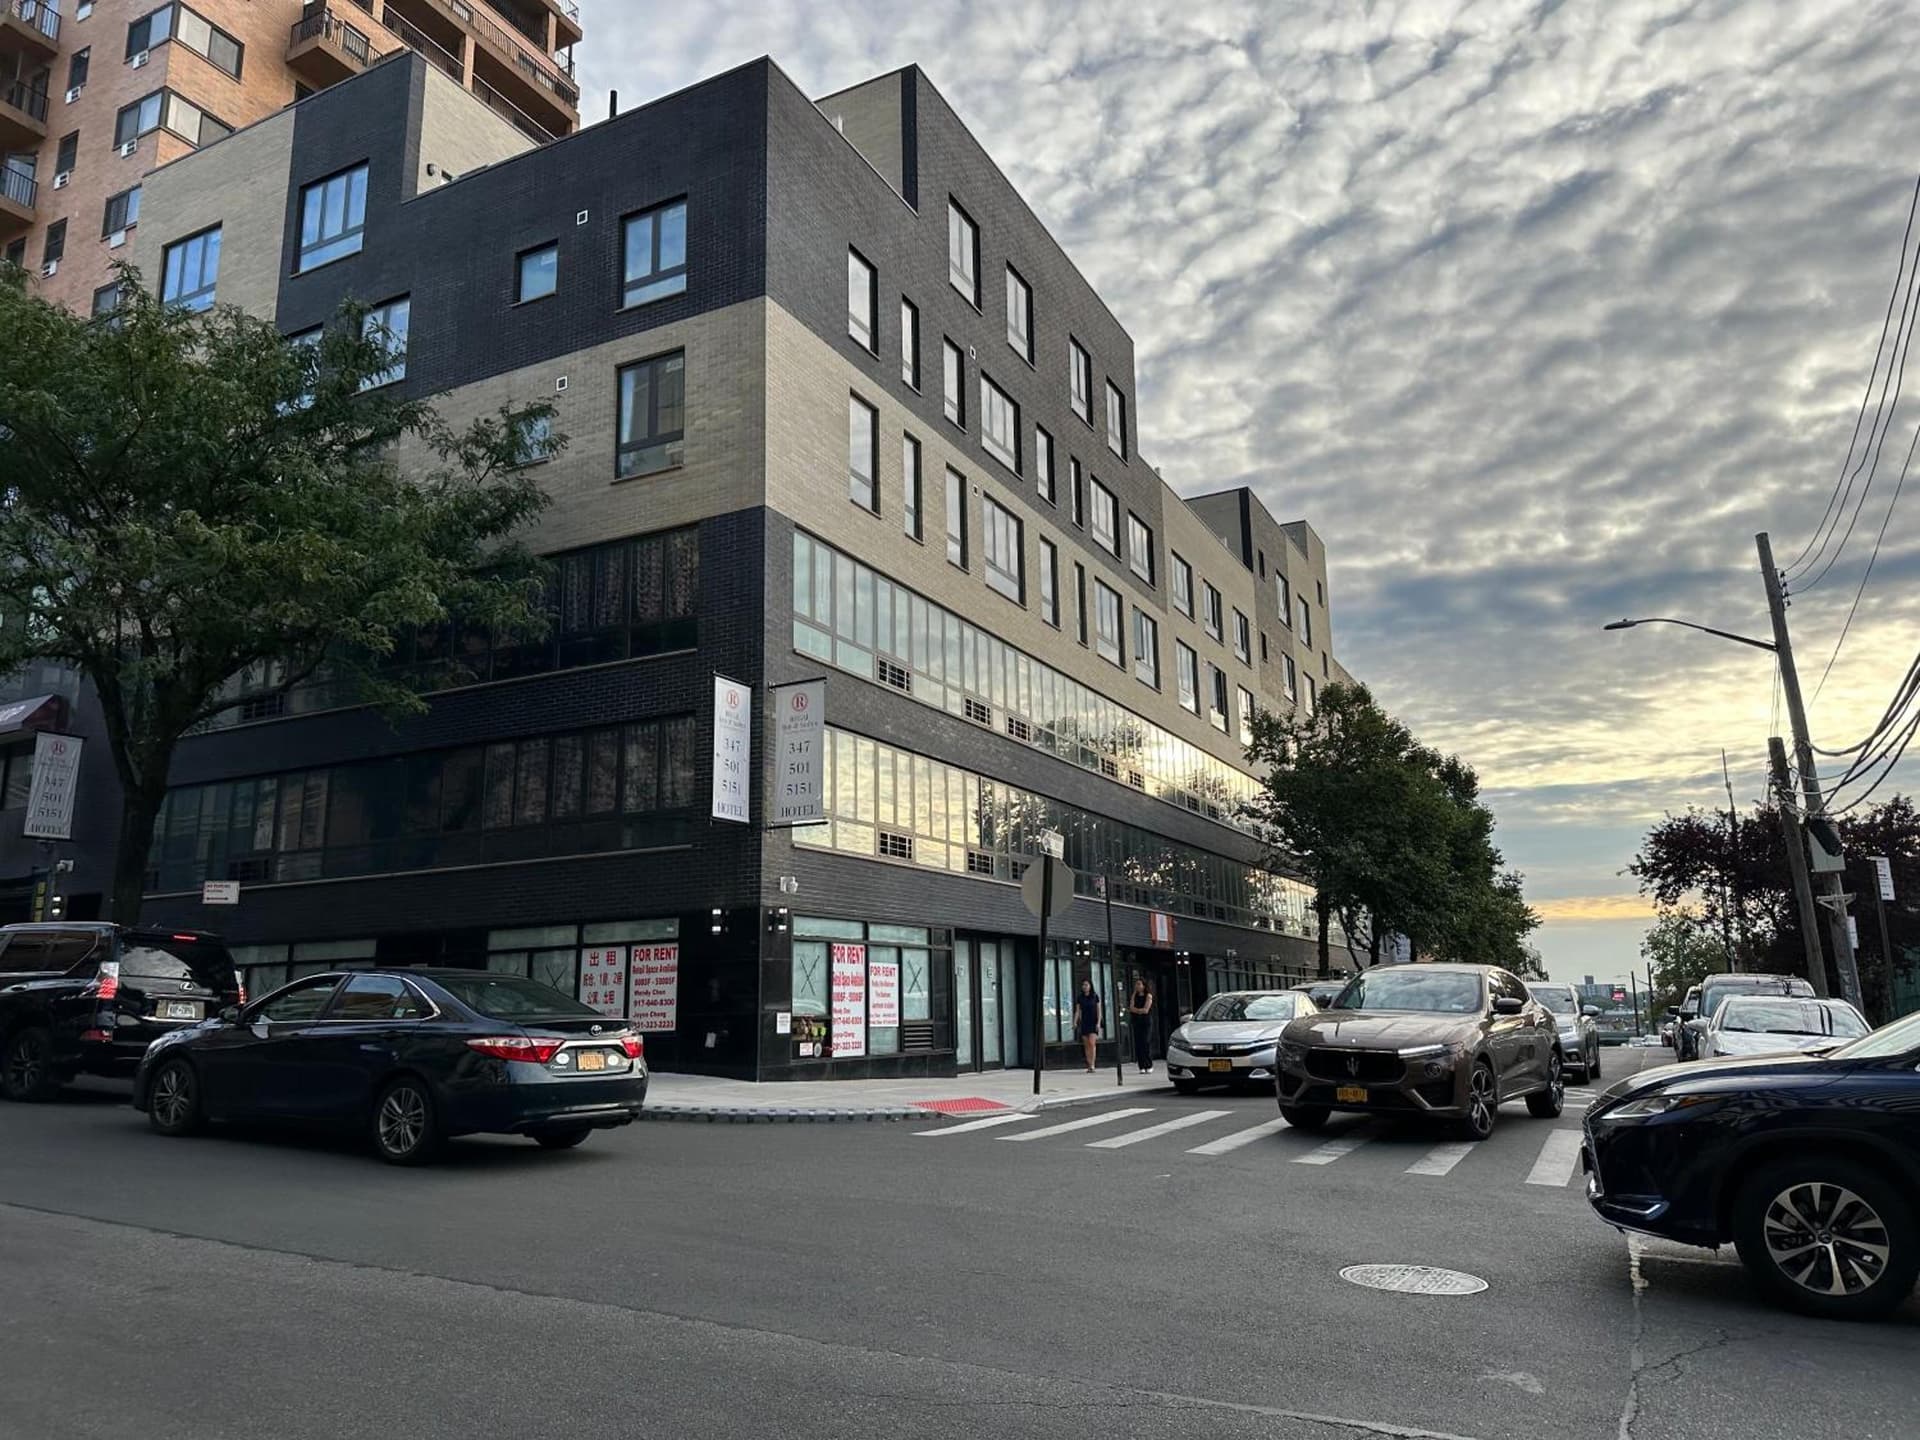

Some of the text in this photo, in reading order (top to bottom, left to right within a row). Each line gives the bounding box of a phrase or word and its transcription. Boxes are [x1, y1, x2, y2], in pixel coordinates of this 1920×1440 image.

[788, 741, 810, 754] 347
[725, 759, 740, 774] 501
[789, 762, 810, 775] 501
[722, 780, 741, 795] 5151
[786, 782, 812, 796] 5151
[717, 802, 744, 818] HOTEL
[781, 805, 818, 817] HOTEL
[634, 947, 677, 962] FOR RENT
[833, 945, 864, 964] FOR RENT
[870, 966, 896, 977] FOR RENT
